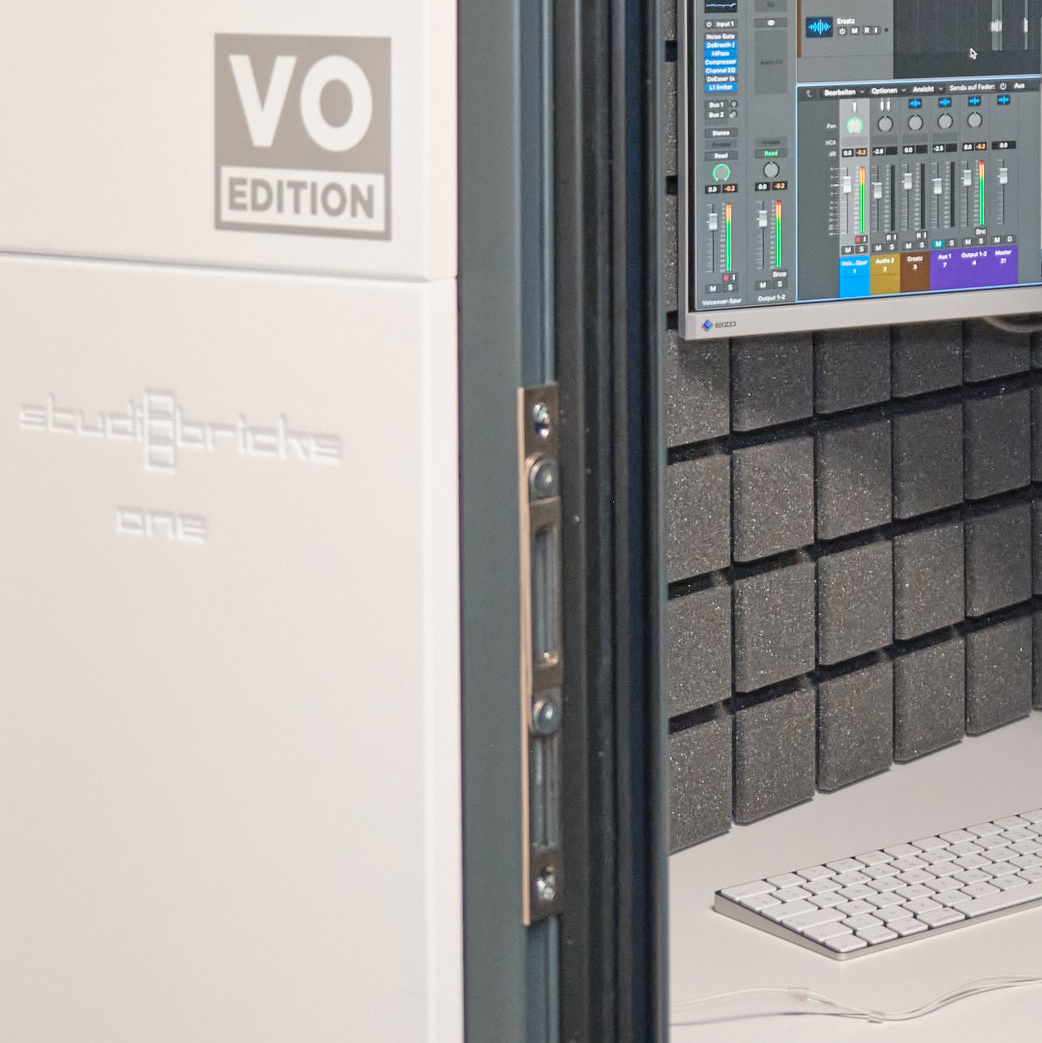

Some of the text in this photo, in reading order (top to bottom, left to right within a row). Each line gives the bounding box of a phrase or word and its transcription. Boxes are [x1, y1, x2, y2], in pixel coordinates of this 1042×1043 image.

[824, 88, 856, 97] Bearbeiten
[872, 87, 897, 95] Optionen
[228, 54, 373, 152] VO
[228, 176, 374, 219] EDITION
[702, 298, 742, 306] Voiceover-Spur
[758, 294, 776, 302] Output
[115, 505, 208, 544] one
